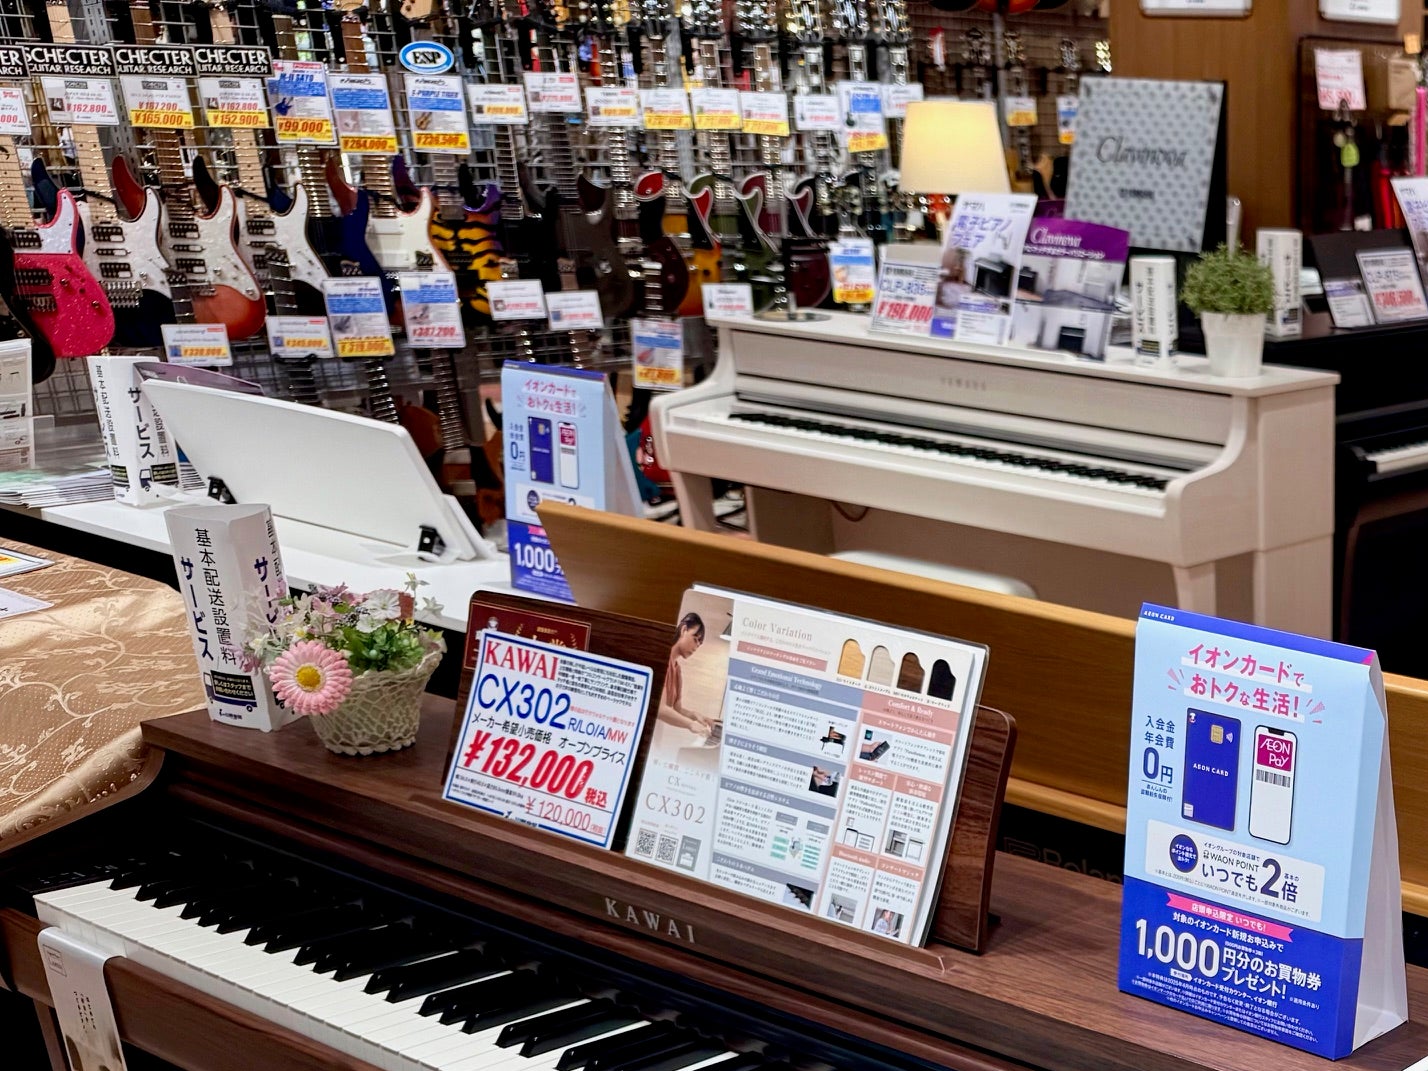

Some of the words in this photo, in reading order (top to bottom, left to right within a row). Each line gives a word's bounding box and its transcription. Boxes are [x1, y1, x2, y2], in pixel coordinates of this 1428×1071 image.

[64, 65, 111, 75] RESEARCH
[116, 49, 192, 66] CHECTER
[148, 65, 193, 75] RESEARCH
[196, 49, 269, 65] CHECTER
[198, 64, 228, 73] UITAR
[230, 64, 268, 74] RESEARCH
[411, 51, 442, 65] ESP
[1097, 137, 1188, 167] Clavinova
[1030, 228, 1082, 248] Clavinova
[127, 387, 155, 459] サービス
[180, 557, 214, 662] サービス
[194, 528, 237, 666] 基本配送設置料
[742, 617, 767, 634] Color
[770, 623, 813, 642] Variation
[484, 640, 559, 681] KAWAI
[1189, 644, 1306, 687] イオンカードで
[751, 667, 769, 677] Grand
[793, 676, 822, 692] Technology
[478, 674, 571, 729] CX302
[888, 700, 910, 710] Comfort
[1190, 673, 1300, 718] おトクな生活!
[1145, 715, 1176, 734] 入会金
[471, 713, 552, 745] メーカー希望小売価格
[557, 736, 626, 765] オープンプライス
[1144, 731, 1175, 750] 年会費
[464, 730, 594, 799] ¥132,000
[1211, 766, 1229, 777] CARD
[1269, 754, 1290, 768] Pay
[585, 787, 608, 808] 税込
[646, 792, 706, 825] CX302
[1204, 842, 1261, 862] イオングループの対象店舗で
[1210, 853, 1235, 866] WAON
[1235, 859, 1260, 873] POINT
[1202, 863, 1258, 892] いつでも
[1282, 881, 1299, 903] 倍
[1284, 872, 1300, 882] 基本の
[605, 897, 695, 943] KAWAI
[1191, 904, 1234, 924] 店頭申込限定
[1235, 915, 1266, 932] いつでも!
[1173, 912, 1284, 953] 対象のイオンカード新規お申込みで
[1136, 918, 1220, 978] 1,000
[1222, 947, 1322, 991] 円分のお買物券
[1221, 967, 1287, 999] プレゼント!
